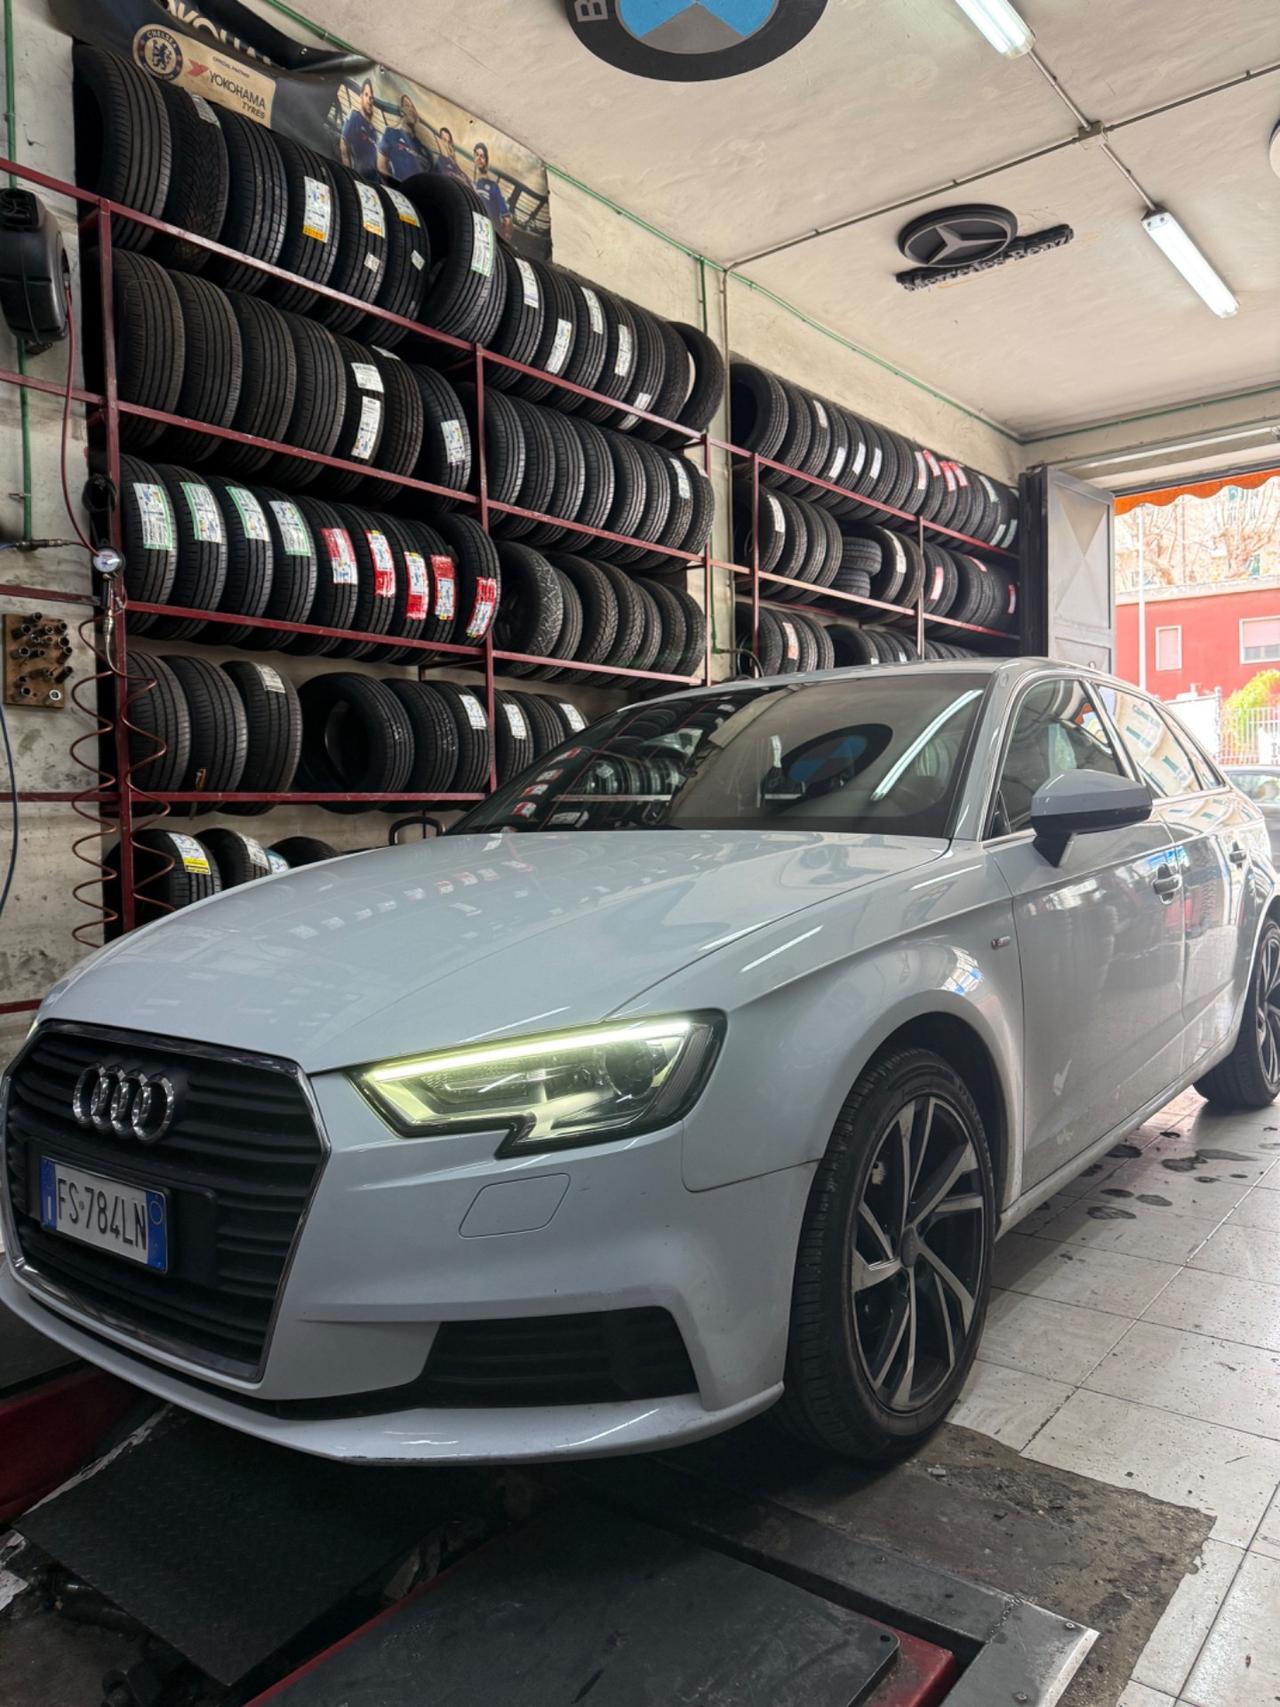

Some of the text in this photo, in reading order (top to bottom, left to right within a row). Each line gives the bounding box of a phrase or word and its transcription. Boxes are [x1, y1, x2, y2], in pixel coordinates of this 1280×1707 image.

[208, 70, 266, 110] YOKOHAMA
[241, 101, 265, 119] TYRES
[57, 1178, 147, 1250] FS 784LN
